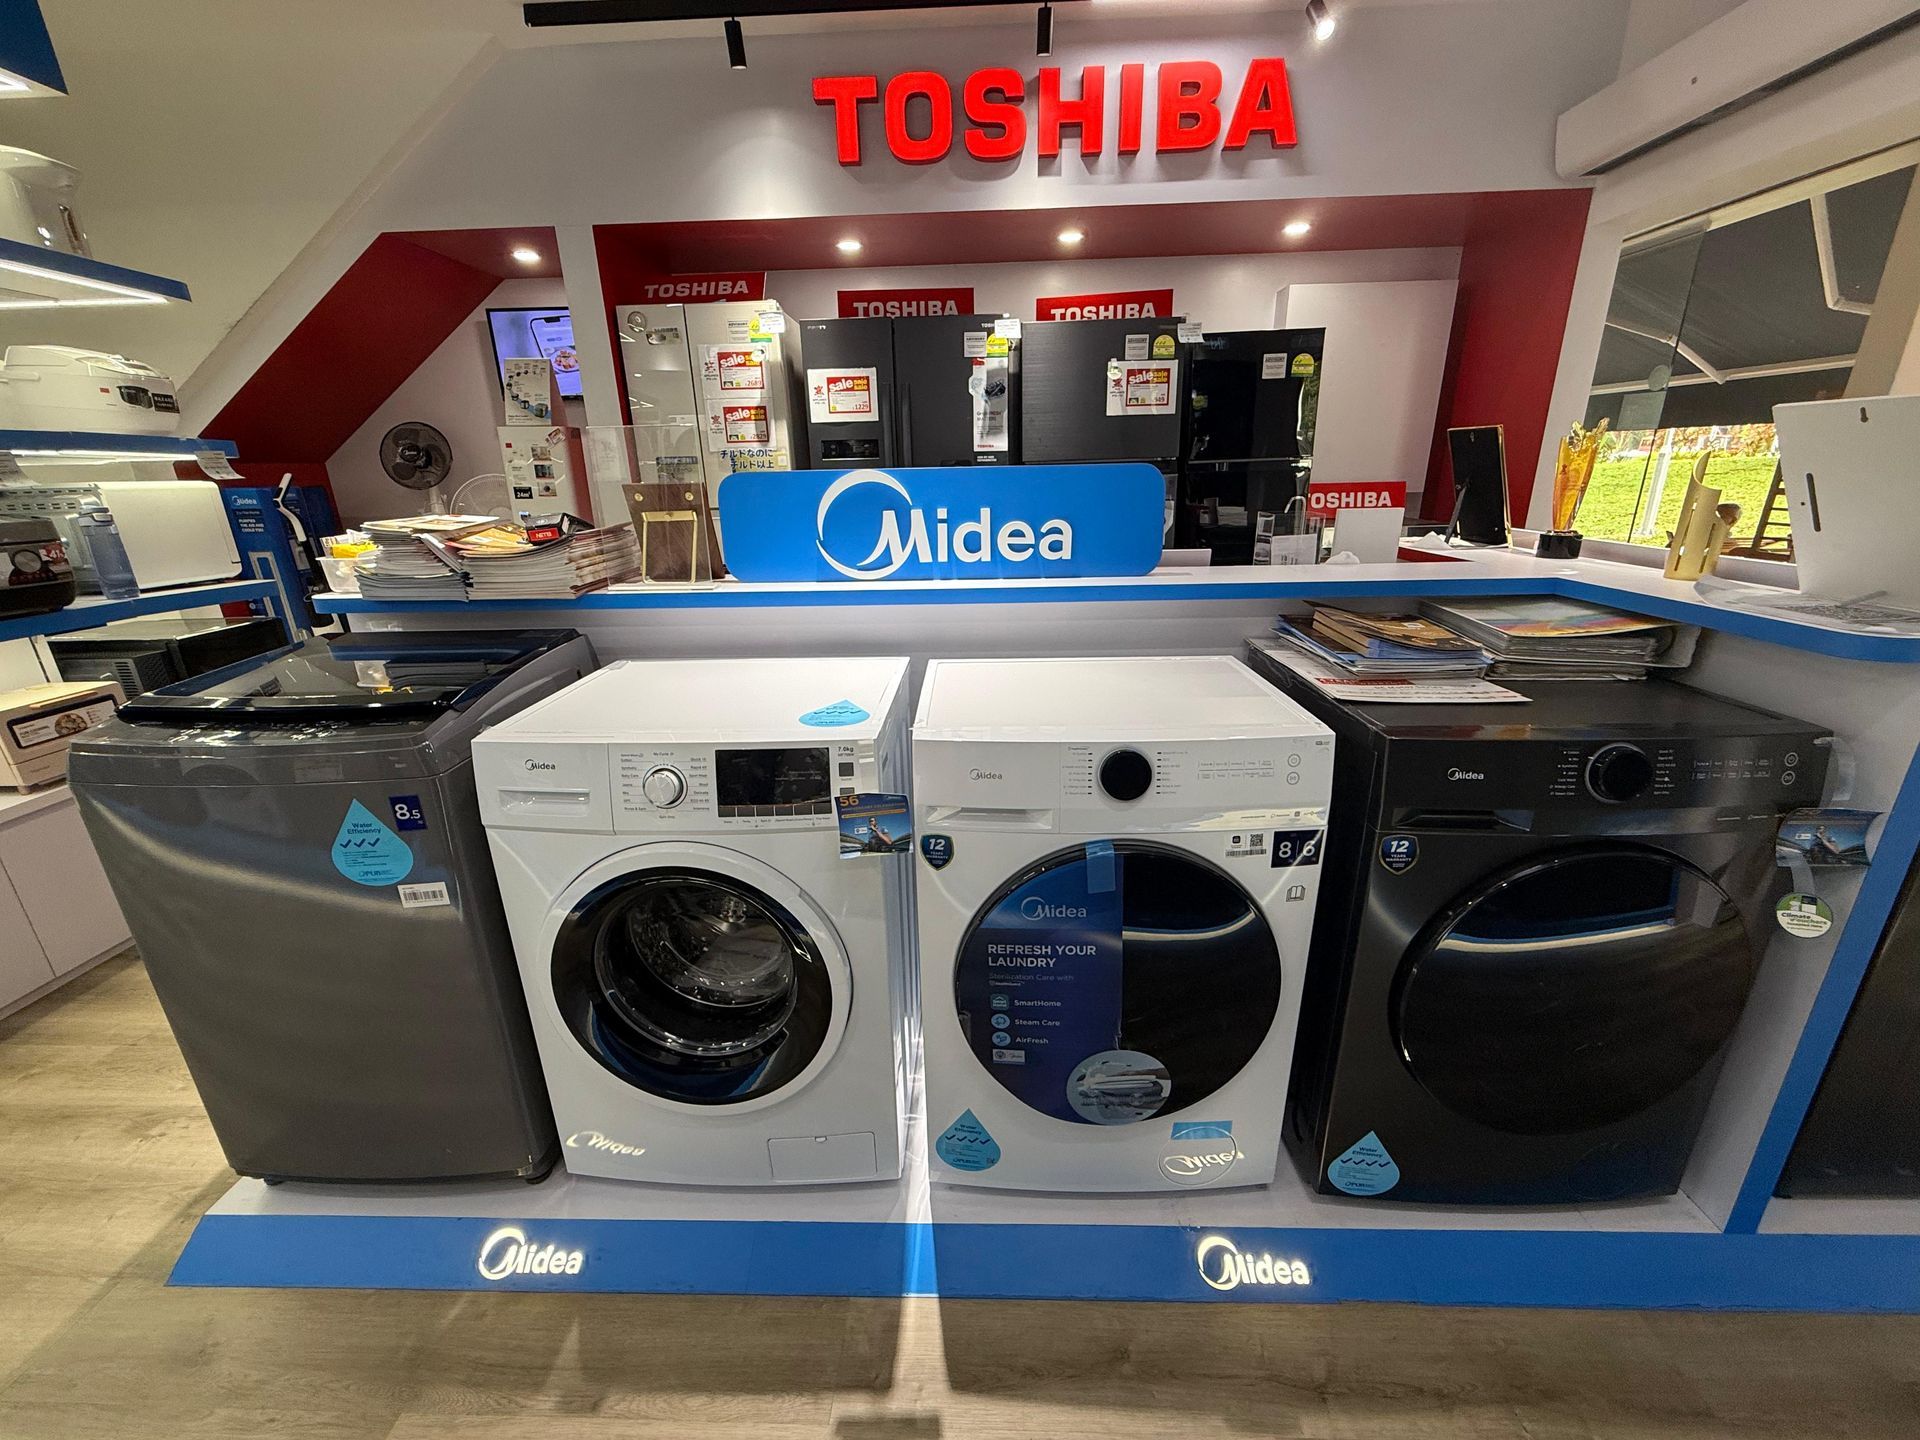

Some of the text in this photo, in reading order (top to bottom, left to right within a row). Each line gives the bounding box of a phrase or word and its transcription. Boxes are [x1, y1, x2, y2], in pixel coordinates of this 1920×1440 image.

[811, 57, 1298, 166] TOSHIBA
[644, 280, 748, 298] TOSHIBA
[853, 300, 958, 318] TOSHIBA
[1050, 302, 1156, 320] TOSHIBA
[720, 354, 745, 367] sale
[1128, 370, 1154, 384] sale
[829, 378, 854, 392] sale
[726, 408, 750, 421] sale
[232, 496, 257, 506] Midea
[1308, 492, 1392, 508] OSHIBA
[816, 469, 1073, 580] Midea
[525, 759, 555, 770] Midea
[970, 768, 1002, 780] Midea
[1448, 768, 1484, 780] Midea
[840, 796, 859, 806] 56
[394, 804, 420, 820] 8.5
[930, 839, 945, 850] 12
[1279, 841, 1315, 858] 8 6
[1391, 840, 1409, 852] 12
[1021, 896, 1086, 920] Midea
[988, 944, 1096, 955] REFRESH YOUR
[988, 957, 1056, 967] LAUNDRY
[479, 1227, 583, 1280] Midea
[1198, 1236, 1310, 1290] Midea
